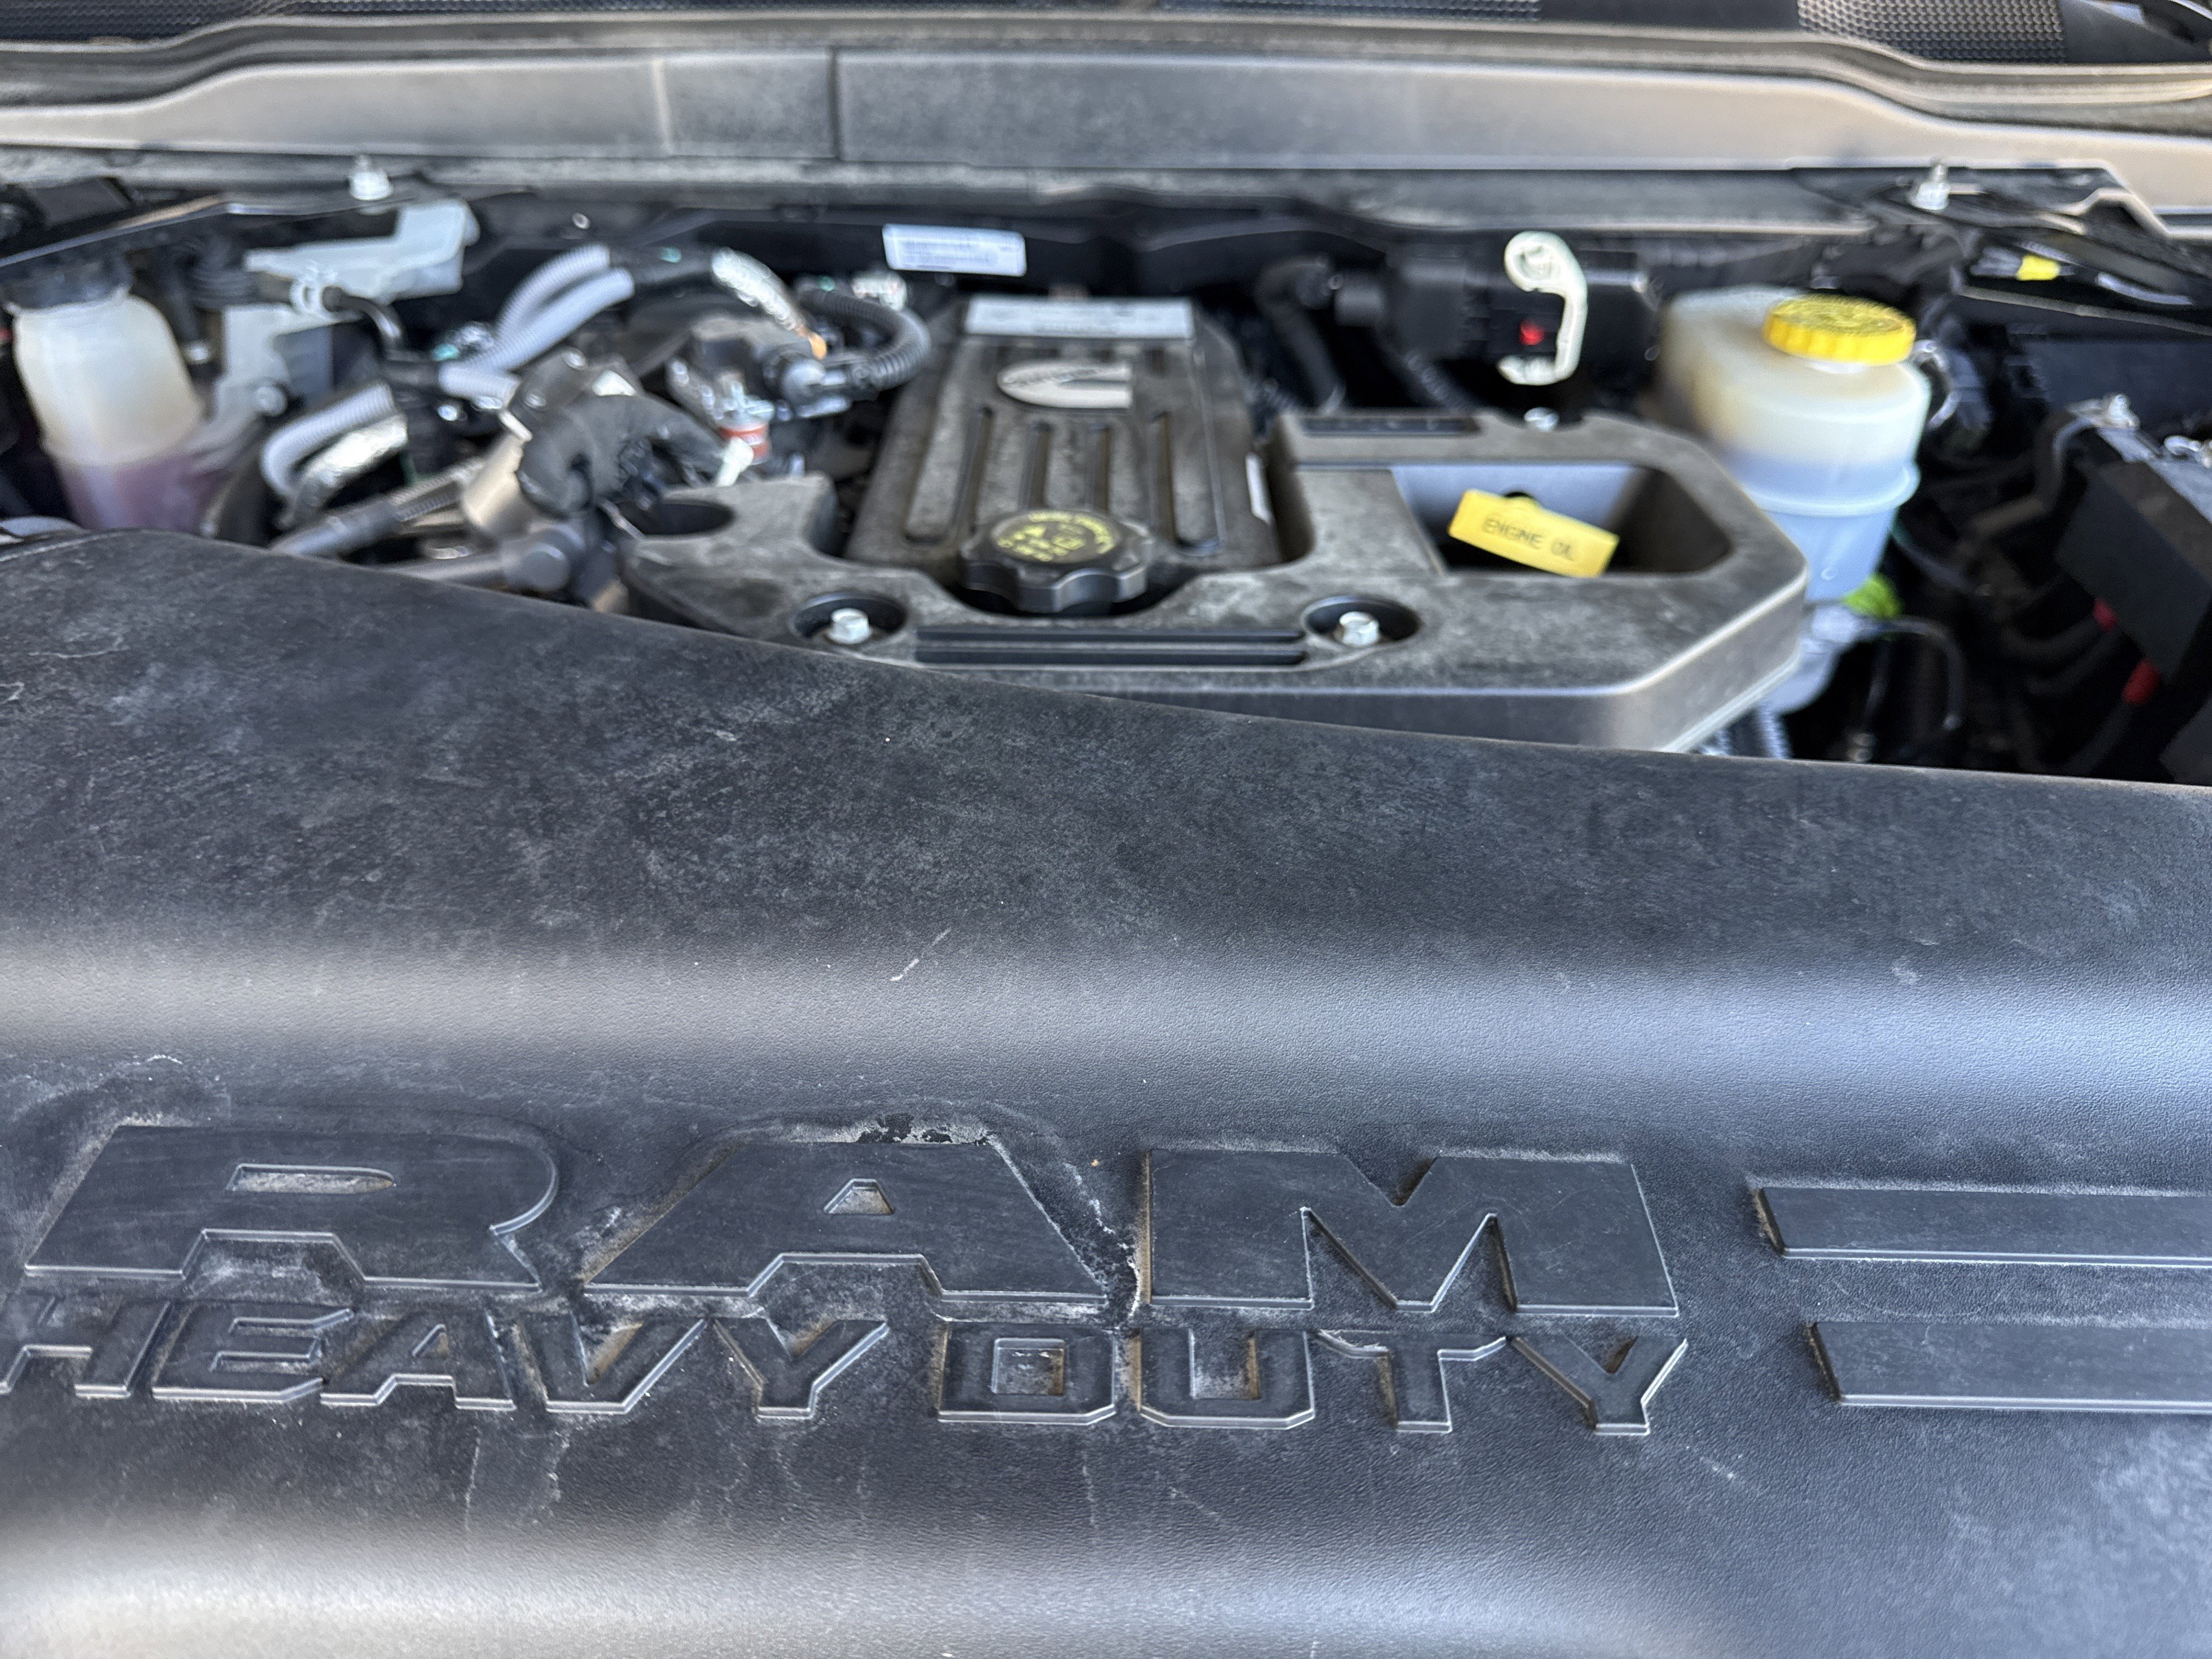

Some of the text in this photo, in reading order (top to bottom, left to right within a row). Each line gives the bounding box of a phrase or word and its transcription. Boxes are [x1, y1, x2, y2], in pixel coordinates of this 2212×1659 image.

[1481, 515, 1581, 561] ENGINE OIL
[22, 1119, 1680, 1318] RAM
